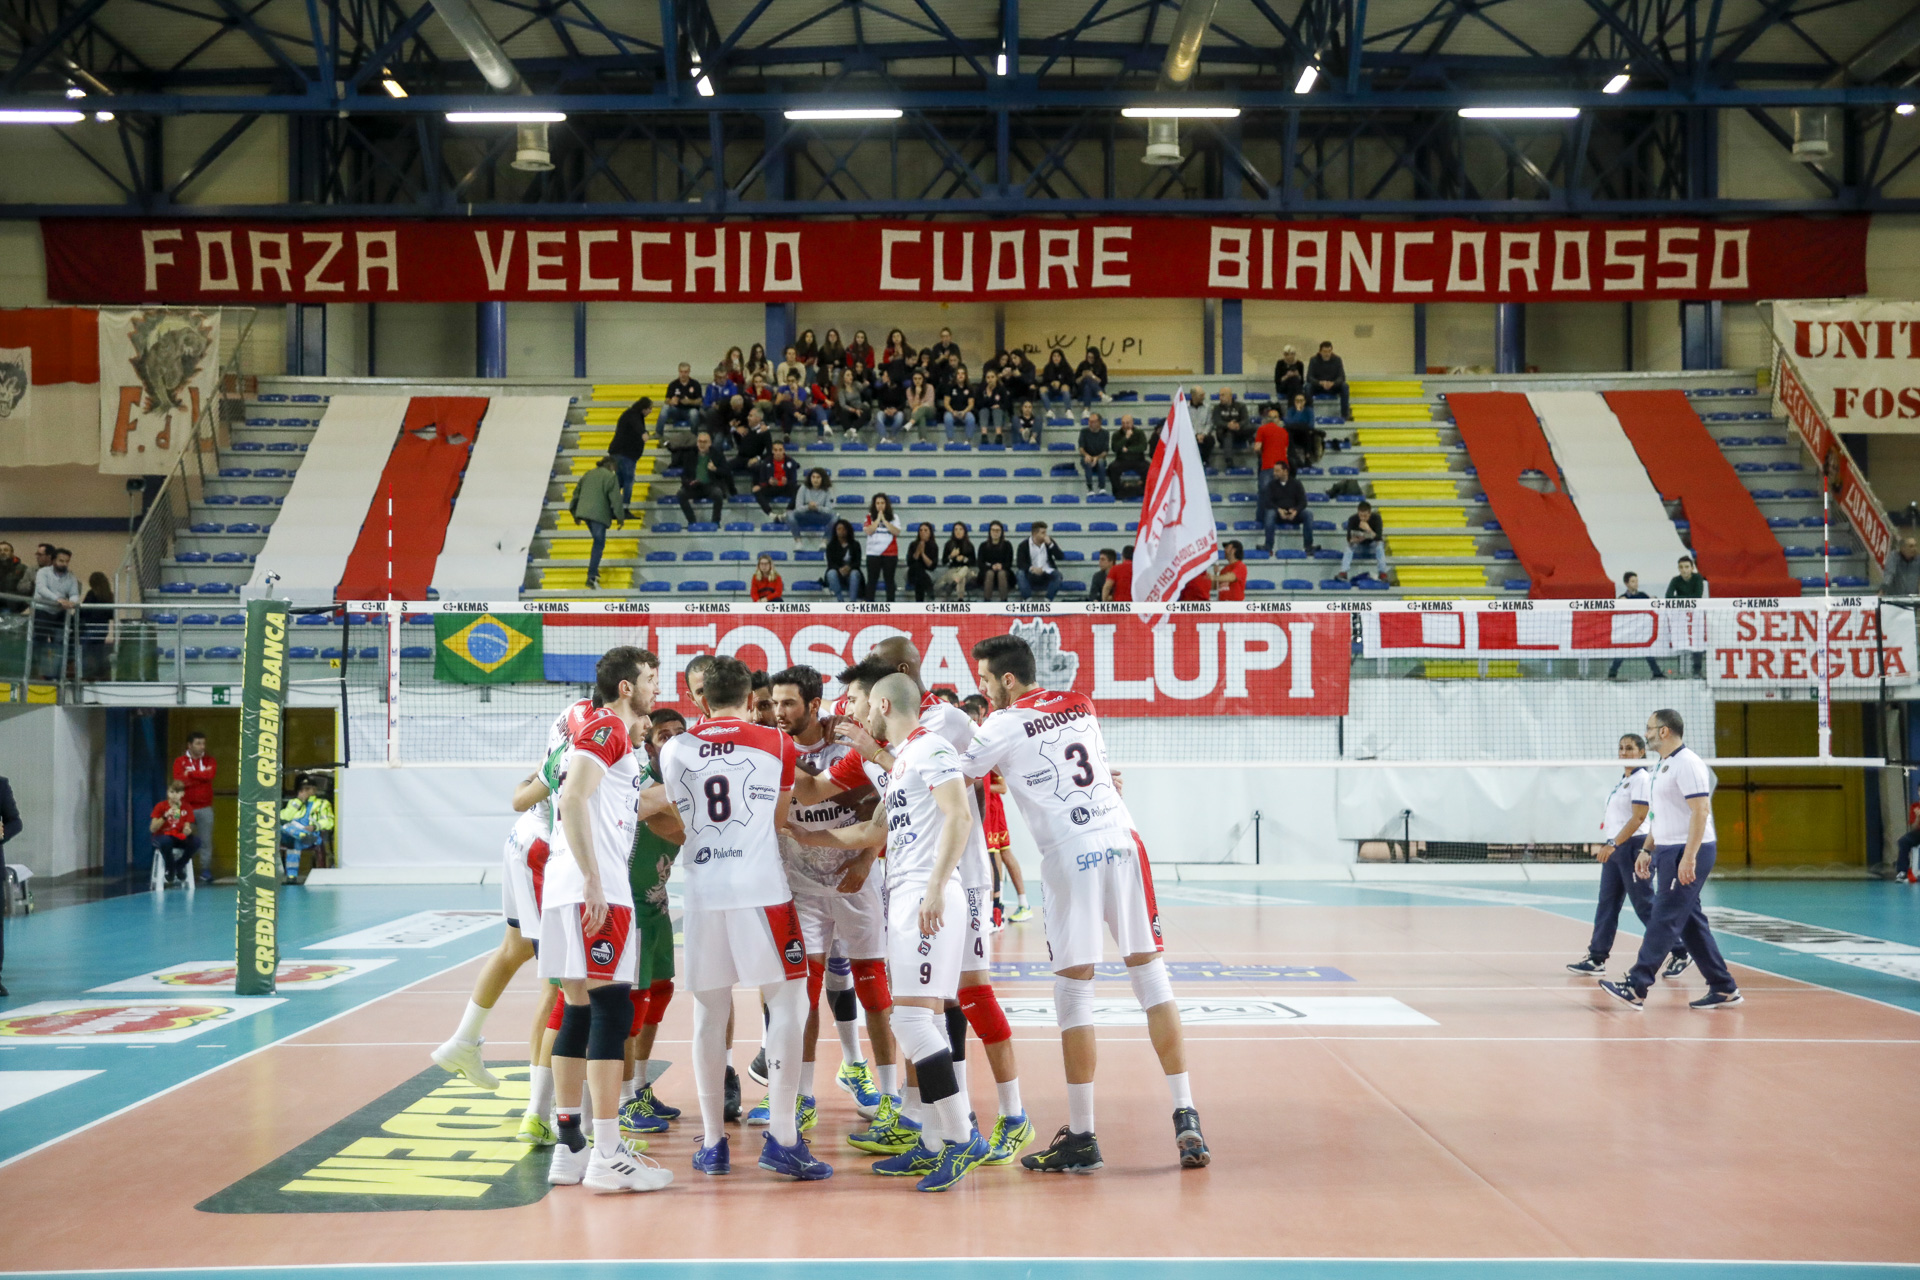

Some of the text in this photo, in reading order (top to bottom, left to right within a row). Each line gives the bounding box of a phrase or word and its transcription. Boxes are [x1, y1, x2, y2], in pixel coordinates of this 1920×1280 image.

[142, 226, 1750, 293] FORZA VECCHIO CUORE BIANCOROSSO
[1736, 611, 1888, 641] SENZA
[655, 621, 1315, 703] FOSSA LUPI
[1715, 646, 1908, 679] TREGUA
[698, 740, 735, 758] CRO
[1064, 742, 1094, 788] 3
[255, 612, 286, 976] CREDEM BANCA CREDEM BANCA
[704, 774, 732, 823] 8
[974, 937, 984, 958] 4
[919, 962, 932, 985] 9
